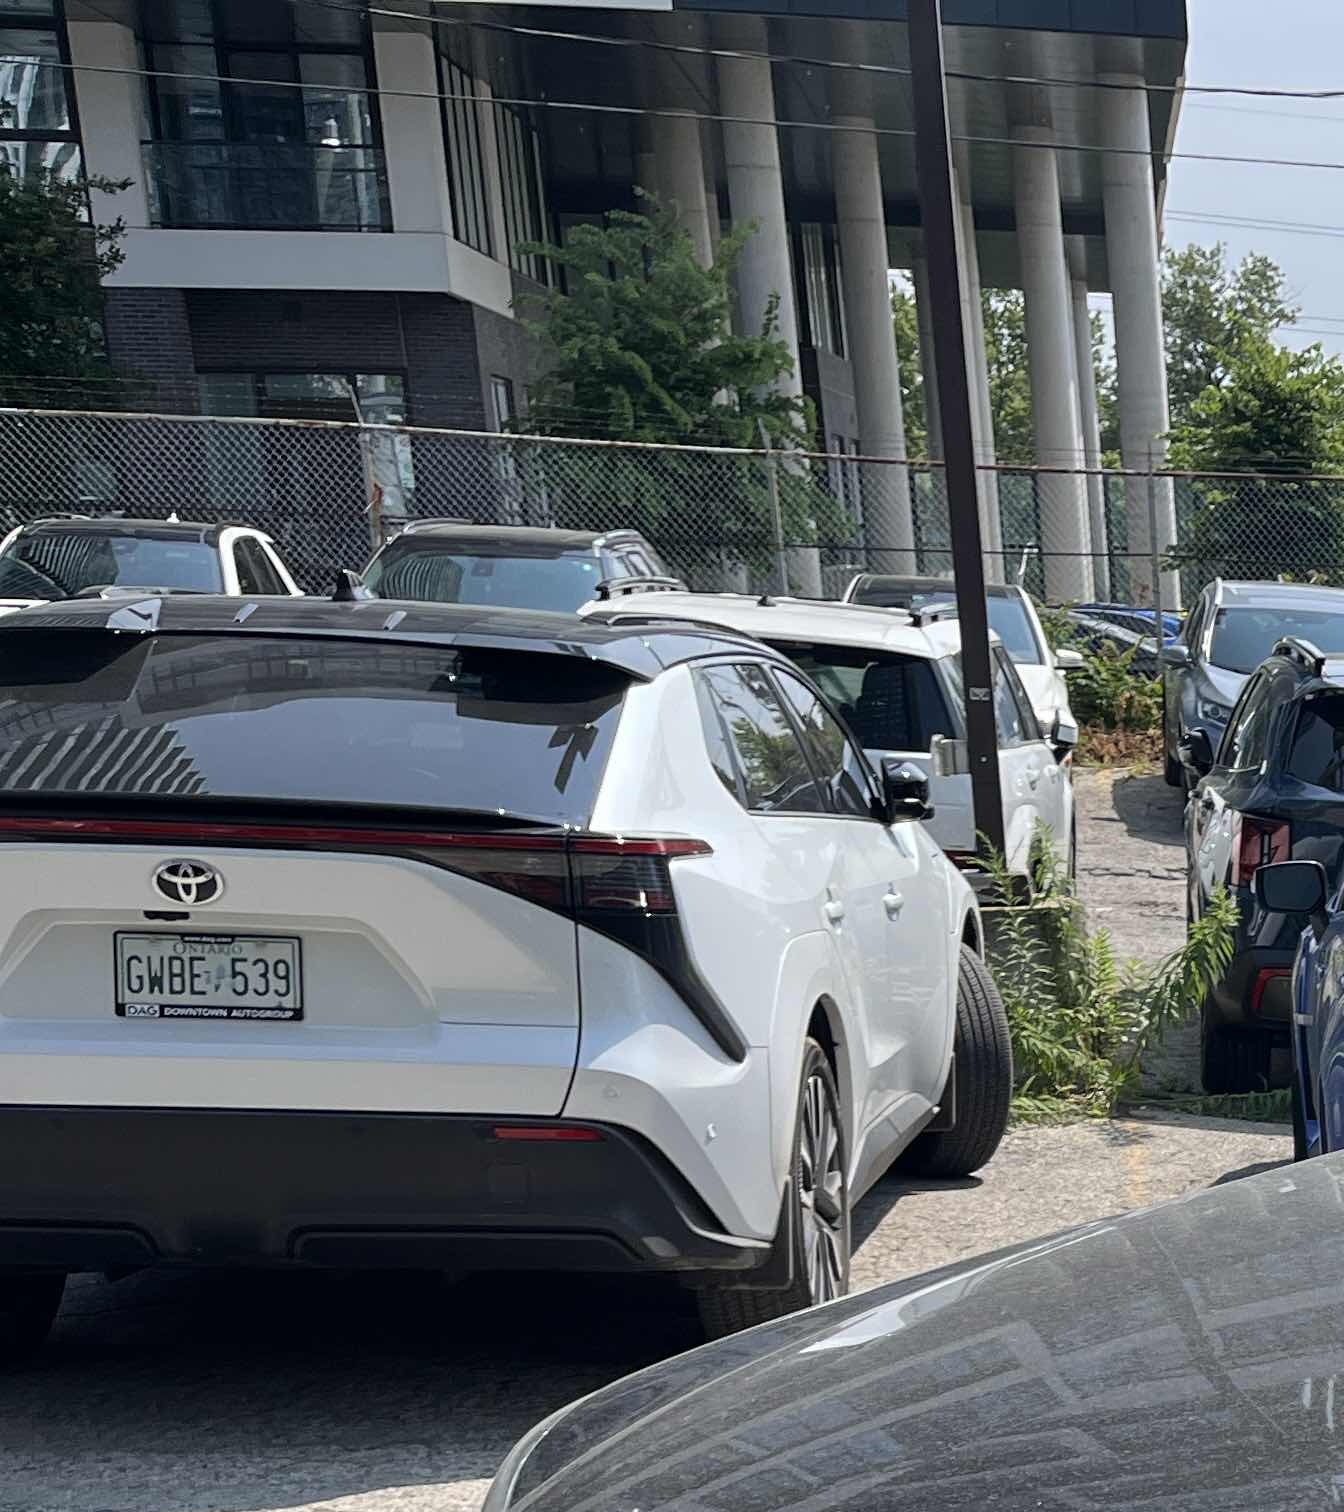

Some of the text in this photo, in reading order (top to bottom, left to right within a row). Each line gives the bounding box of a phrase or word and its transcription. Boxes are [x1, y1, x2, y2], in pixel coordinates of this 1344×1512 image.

[126, 955, 291, 997] GWBE 539
[163, 1007, 228, 1018] DOWNTOWN
[230, 1008, 294, 1019] AUTOGROUP
